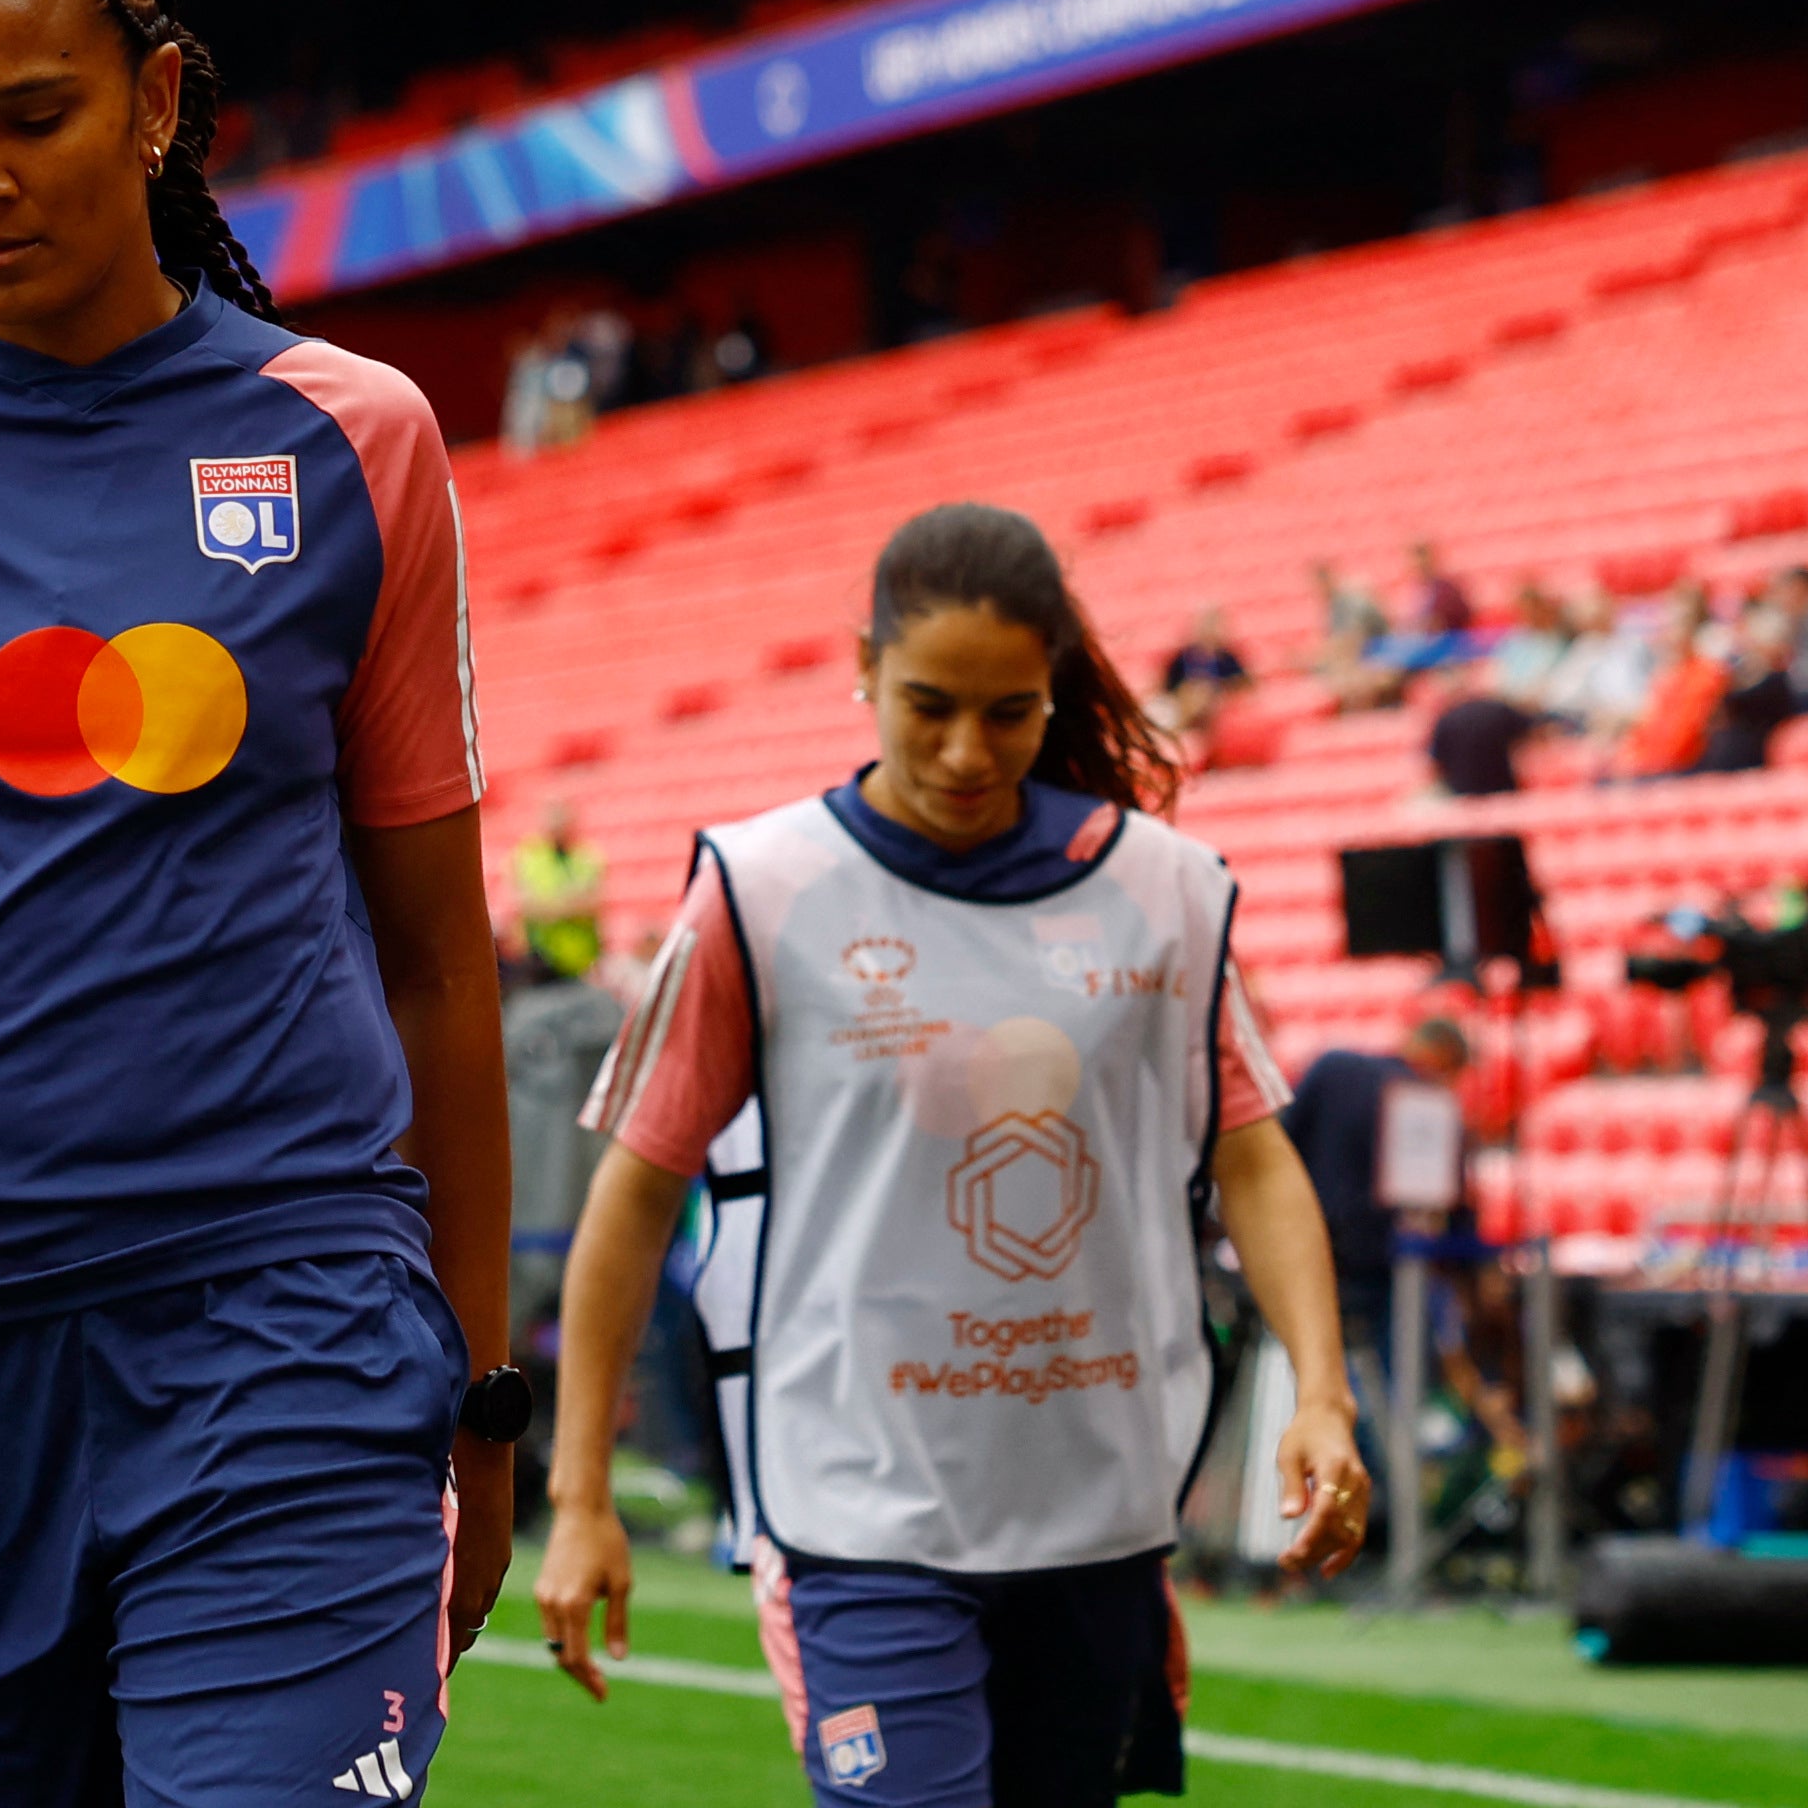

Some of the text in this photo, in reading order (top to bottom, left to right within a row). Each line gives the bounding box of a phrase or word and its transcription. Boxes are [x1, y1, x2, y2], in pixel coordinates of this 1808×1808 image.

[201, 463, 287, 478] OLYMPIQUE
[202, 477, 288, 492] LYONNAIS
[208, 501, 288, 549] OL
[382, 1690, 405, 1733] 3
